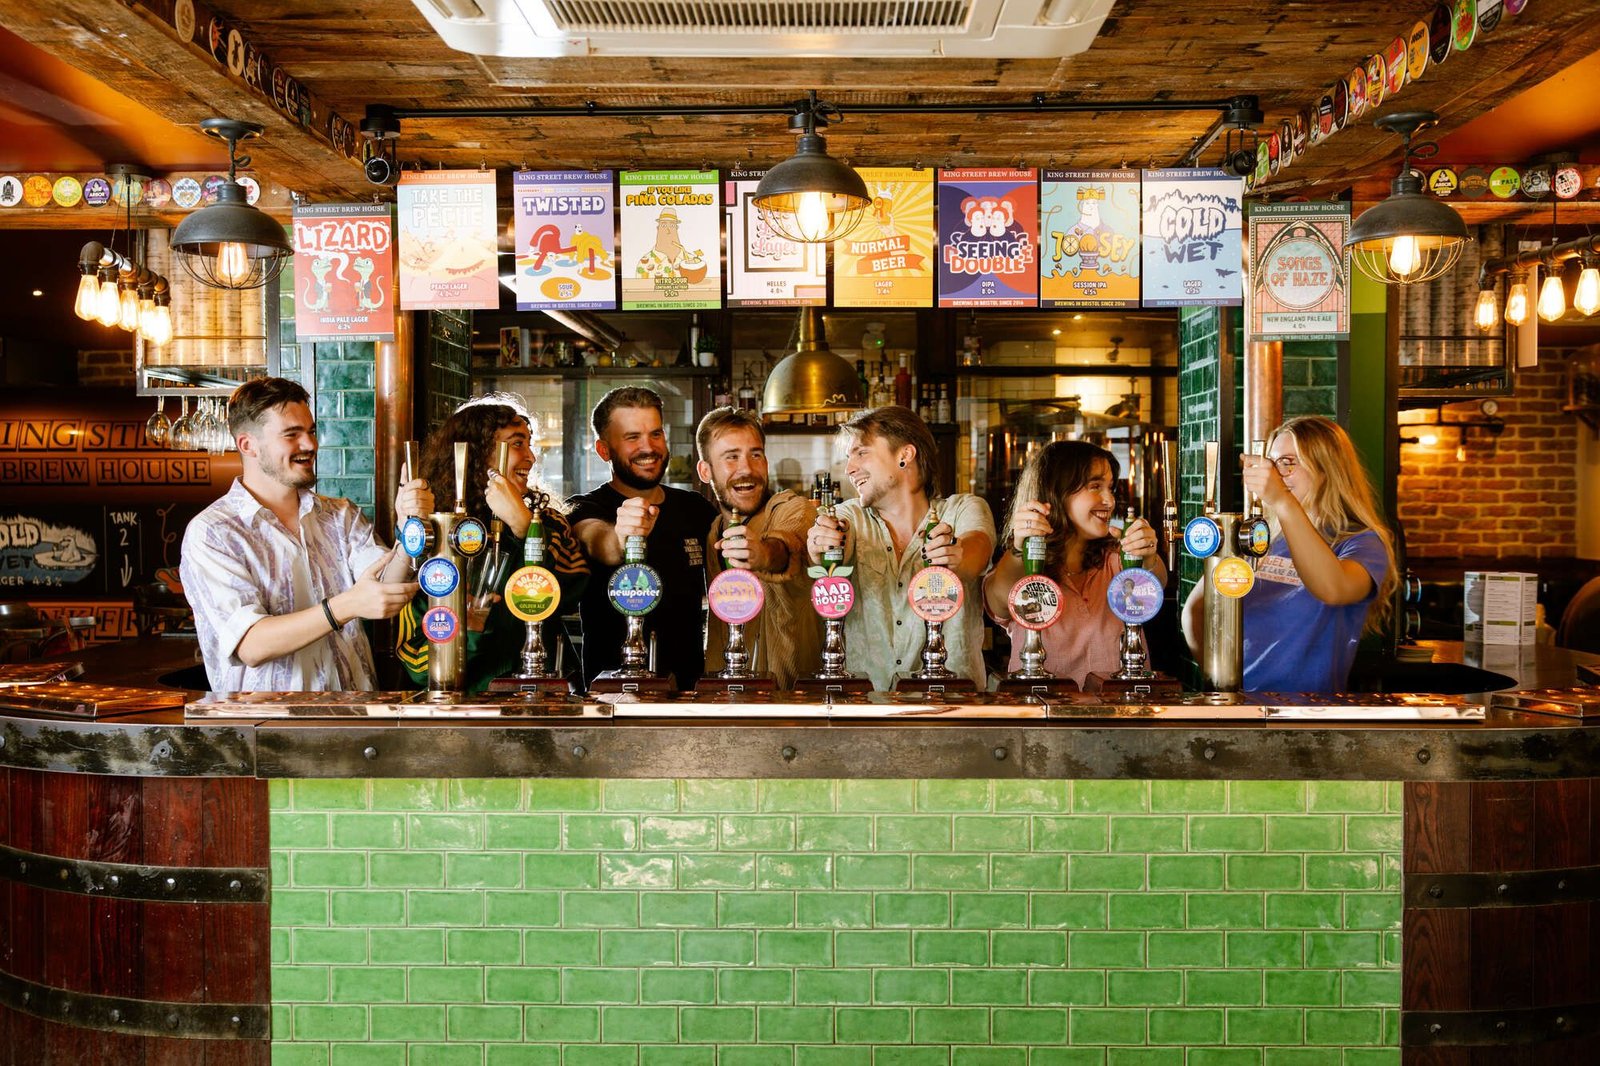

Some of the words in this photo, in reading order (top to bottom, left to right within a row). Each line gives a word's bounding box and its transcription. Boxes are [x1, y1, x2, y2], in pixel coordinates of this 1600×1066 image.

[412, 188, 450, 204] TAKE
[455, 188, 483, 203] THE
[626, 190, 657, 206] PIÑA
[659, 194, 715, 206] COLADAS
[646, 186, 656, 195] IF
[656, 186, 673, 195] YOU
[674, 185, 693, 194] LIKE
[523, 196, 606, 215] TWISTED
[1160, 205, 1226, 244] COLD
[297, 223, 388, 251] LIZARD
[752, 237, 799, 260] Lager
[851, 238, 905, 253] NORMAL
[958, 242, 1021, 259] SEEING
[1164, 241, 1224, 263] WET
[872, 256, 906, 271] BEER
[951, 256, 1025, 273] DOUBLE
[1276, 256, 1323, 270] SONGS
[1073, 281, 1096, 289] SESSION
[1269, 272, 1289, 286] OF
[1292, 272, 1328, 286] HAZE
[1, 422, 78, 447] ING
[2, 461, 87, 480] BREW
[101, 461, 208, 480] HOUSE
[110, 512, 138, 526] TANK
[120, 528, 129, 546] 2
[610, 589, 661, 599] newporter
[813, 583, 850, 597] MAD
[815, 594, 851, 606] HOUSE
